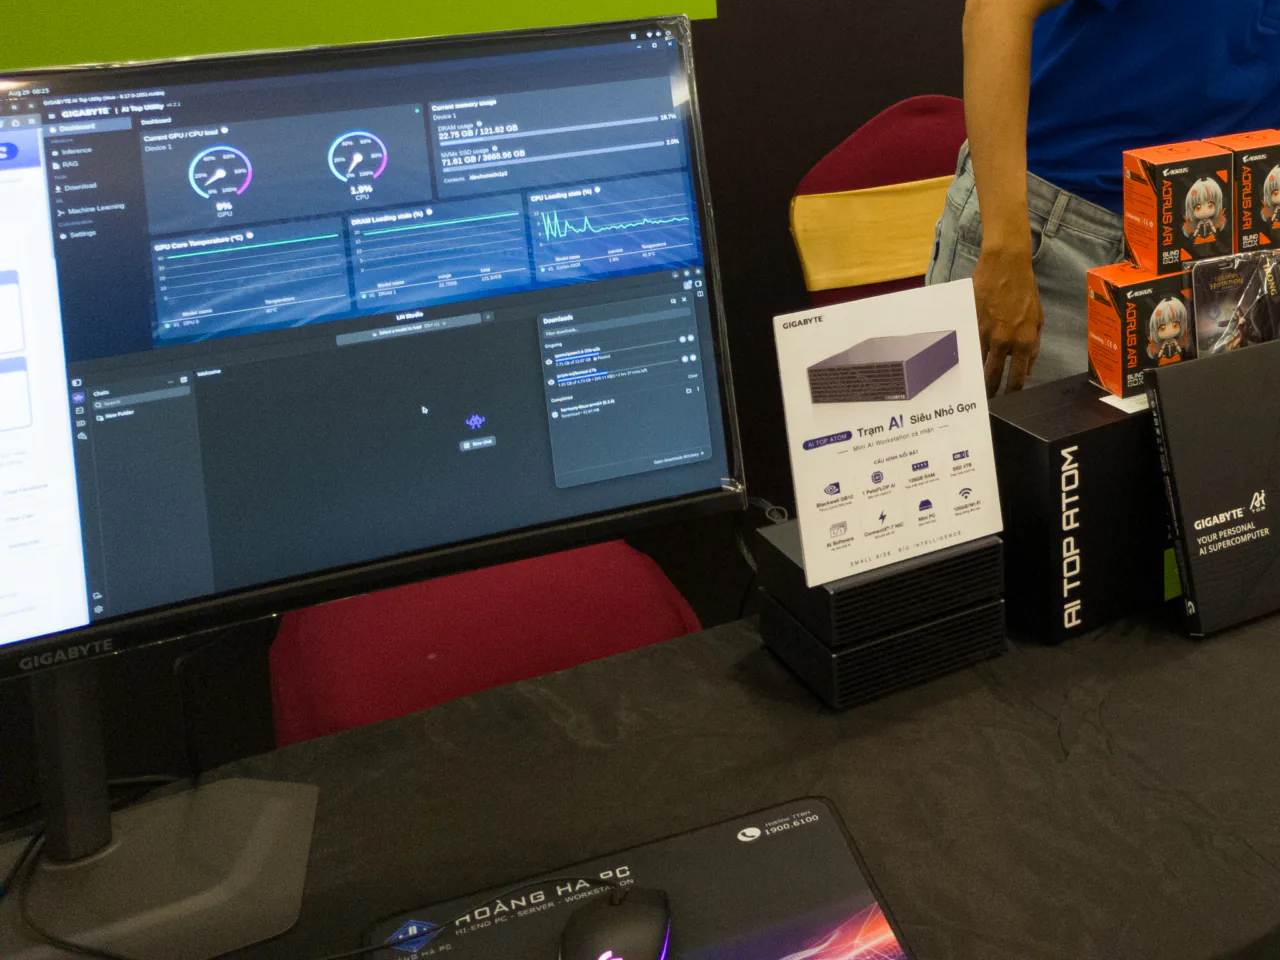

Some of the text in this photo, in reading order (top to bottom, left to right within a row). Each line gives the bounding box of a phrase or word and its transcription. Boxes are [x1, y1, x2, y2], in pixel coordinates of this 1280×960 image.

[61, 107, 110, 119] GIGABYTE
[130, 104, 143, 114] Top
[144, 102, 165, 112] Utility
[432, 99, 497, 112] Current memory usage
[59, 122, 96, 133] Dashboard
[438, 124, 456, 132] DRAM
[461, 129, 474, 137] GB
[506, 124, 519, 132] GB
[144, 129, 219, 143] Current GPU CPU load
[61, 147, 93, 157] Inference
[464, 155, 477, 164] GB
[513, 150, 526, 158] GB
[62, 160, 79, 168] RAG
[64, 182, 97, 191] Download
[545, 192, 568, 201] Loading
[68, 202, 126, 215] Machine Learning
[351, 218, 371, 226] DRAM
[372, 214, 396, 224] Loading
[70, 229, 97, 240] Settings
[154, 244, 171, 252] GPU
[188, 236, 229, 248] Temperature
[543, 314, 574, 325] Downloads
[782, 315, 823, 330] GIGABYTE
[857, 425, 884, 438] Trạm
[888, 414, 904, 431] AI
[910, 412, 932, 425] Siêu
[934, 404, 954, 419] Nhỏ
[956, 401, 977, 414] Gọn
[1194, 507, 1244, 530] GIGABYTE
[1061, 445, 1081, 629] AI TOP ATOM
[1197, 521, 1256, 545] YOUR PERSONAL
[1199, 527, 1270, 556] AI SUPERCOMPUTER
[20, 638, 113, 670] GIGABYTE
[765, 814, 819, 836] 1900.6100
[517, 901, 555, 917] SERVER
[564, 878, 635, 903] WORKSTAON
